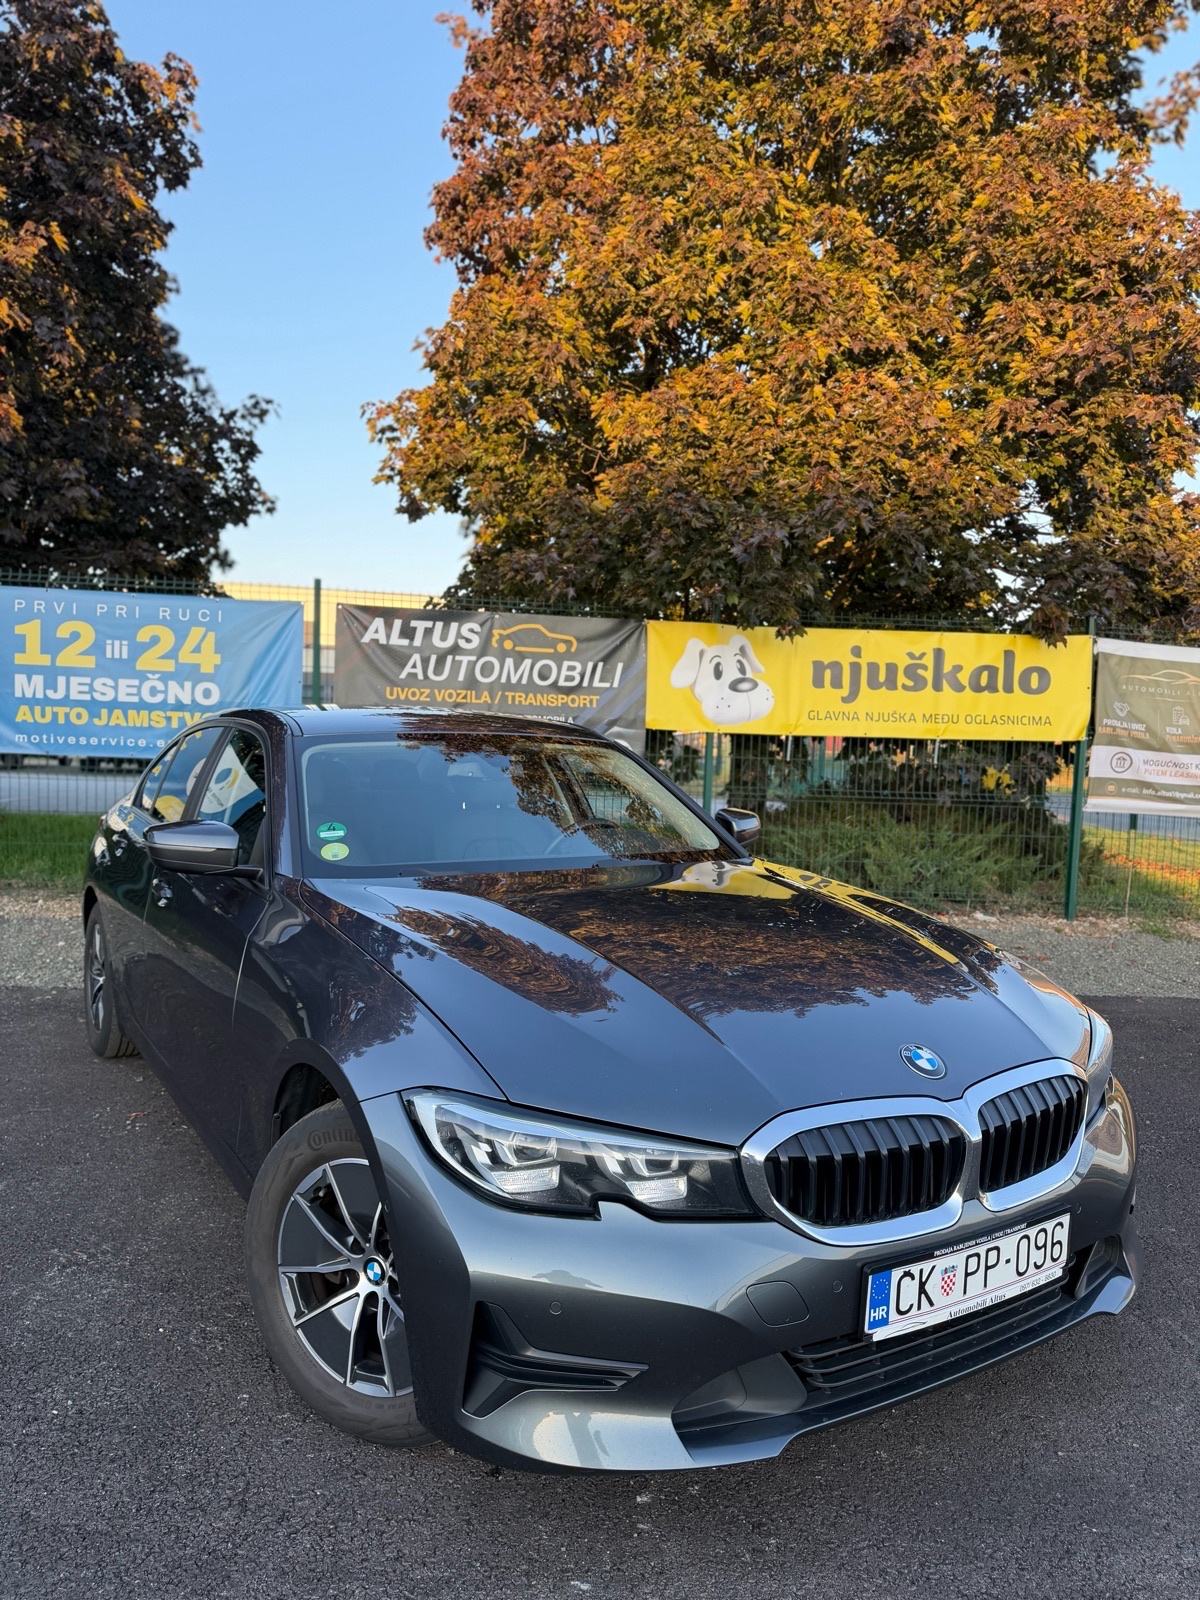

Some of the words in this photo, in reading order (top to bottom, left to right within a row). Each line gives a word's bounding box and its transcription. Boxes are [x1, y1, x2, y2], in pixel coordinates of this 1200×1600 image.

[14, 599, 77, 615] PRVI
[96, 604, 140, 618] PRI
[159, 607, 222, 622] RUCI
[360, 617, 481, 649] ALTUS
[13, 619, 96, 668] 12
[105, 640, 129, 659] ili
[135, 625, 222, 673] 24
[399, 653, 624, 688] AUTOMOBILI
[811, 645, 1052, 704] njuškalo
[13, 673, 221, 706] MJESEČNO
[385, 686, 431, 702] UVOZ
[434, 689, 492, 704] VOZILA
[494, 691, 502, 705] /
[504, 691, 600, 708] TRANSPORT
[15, 705, 89, 725] AUTO
[808, 709, 860, 721] GLAVNA
[865, 709, 917, 724] NJUŠKA
[964, 713, 1053, 727] OGLASNICIMA
[15, 733, 170, 748] motiveservice.e
[1143, 758, 1194, 770] MOGUĆNOST
[895, 1264, 937, 1316] ČK
[962, 1221, 1065, 1296] PP-096
[869, 1305, 887, 1322] HR
[946, 1298, 988, 1320] Automobili
[987, 1292, 1007, 1306] Altus
